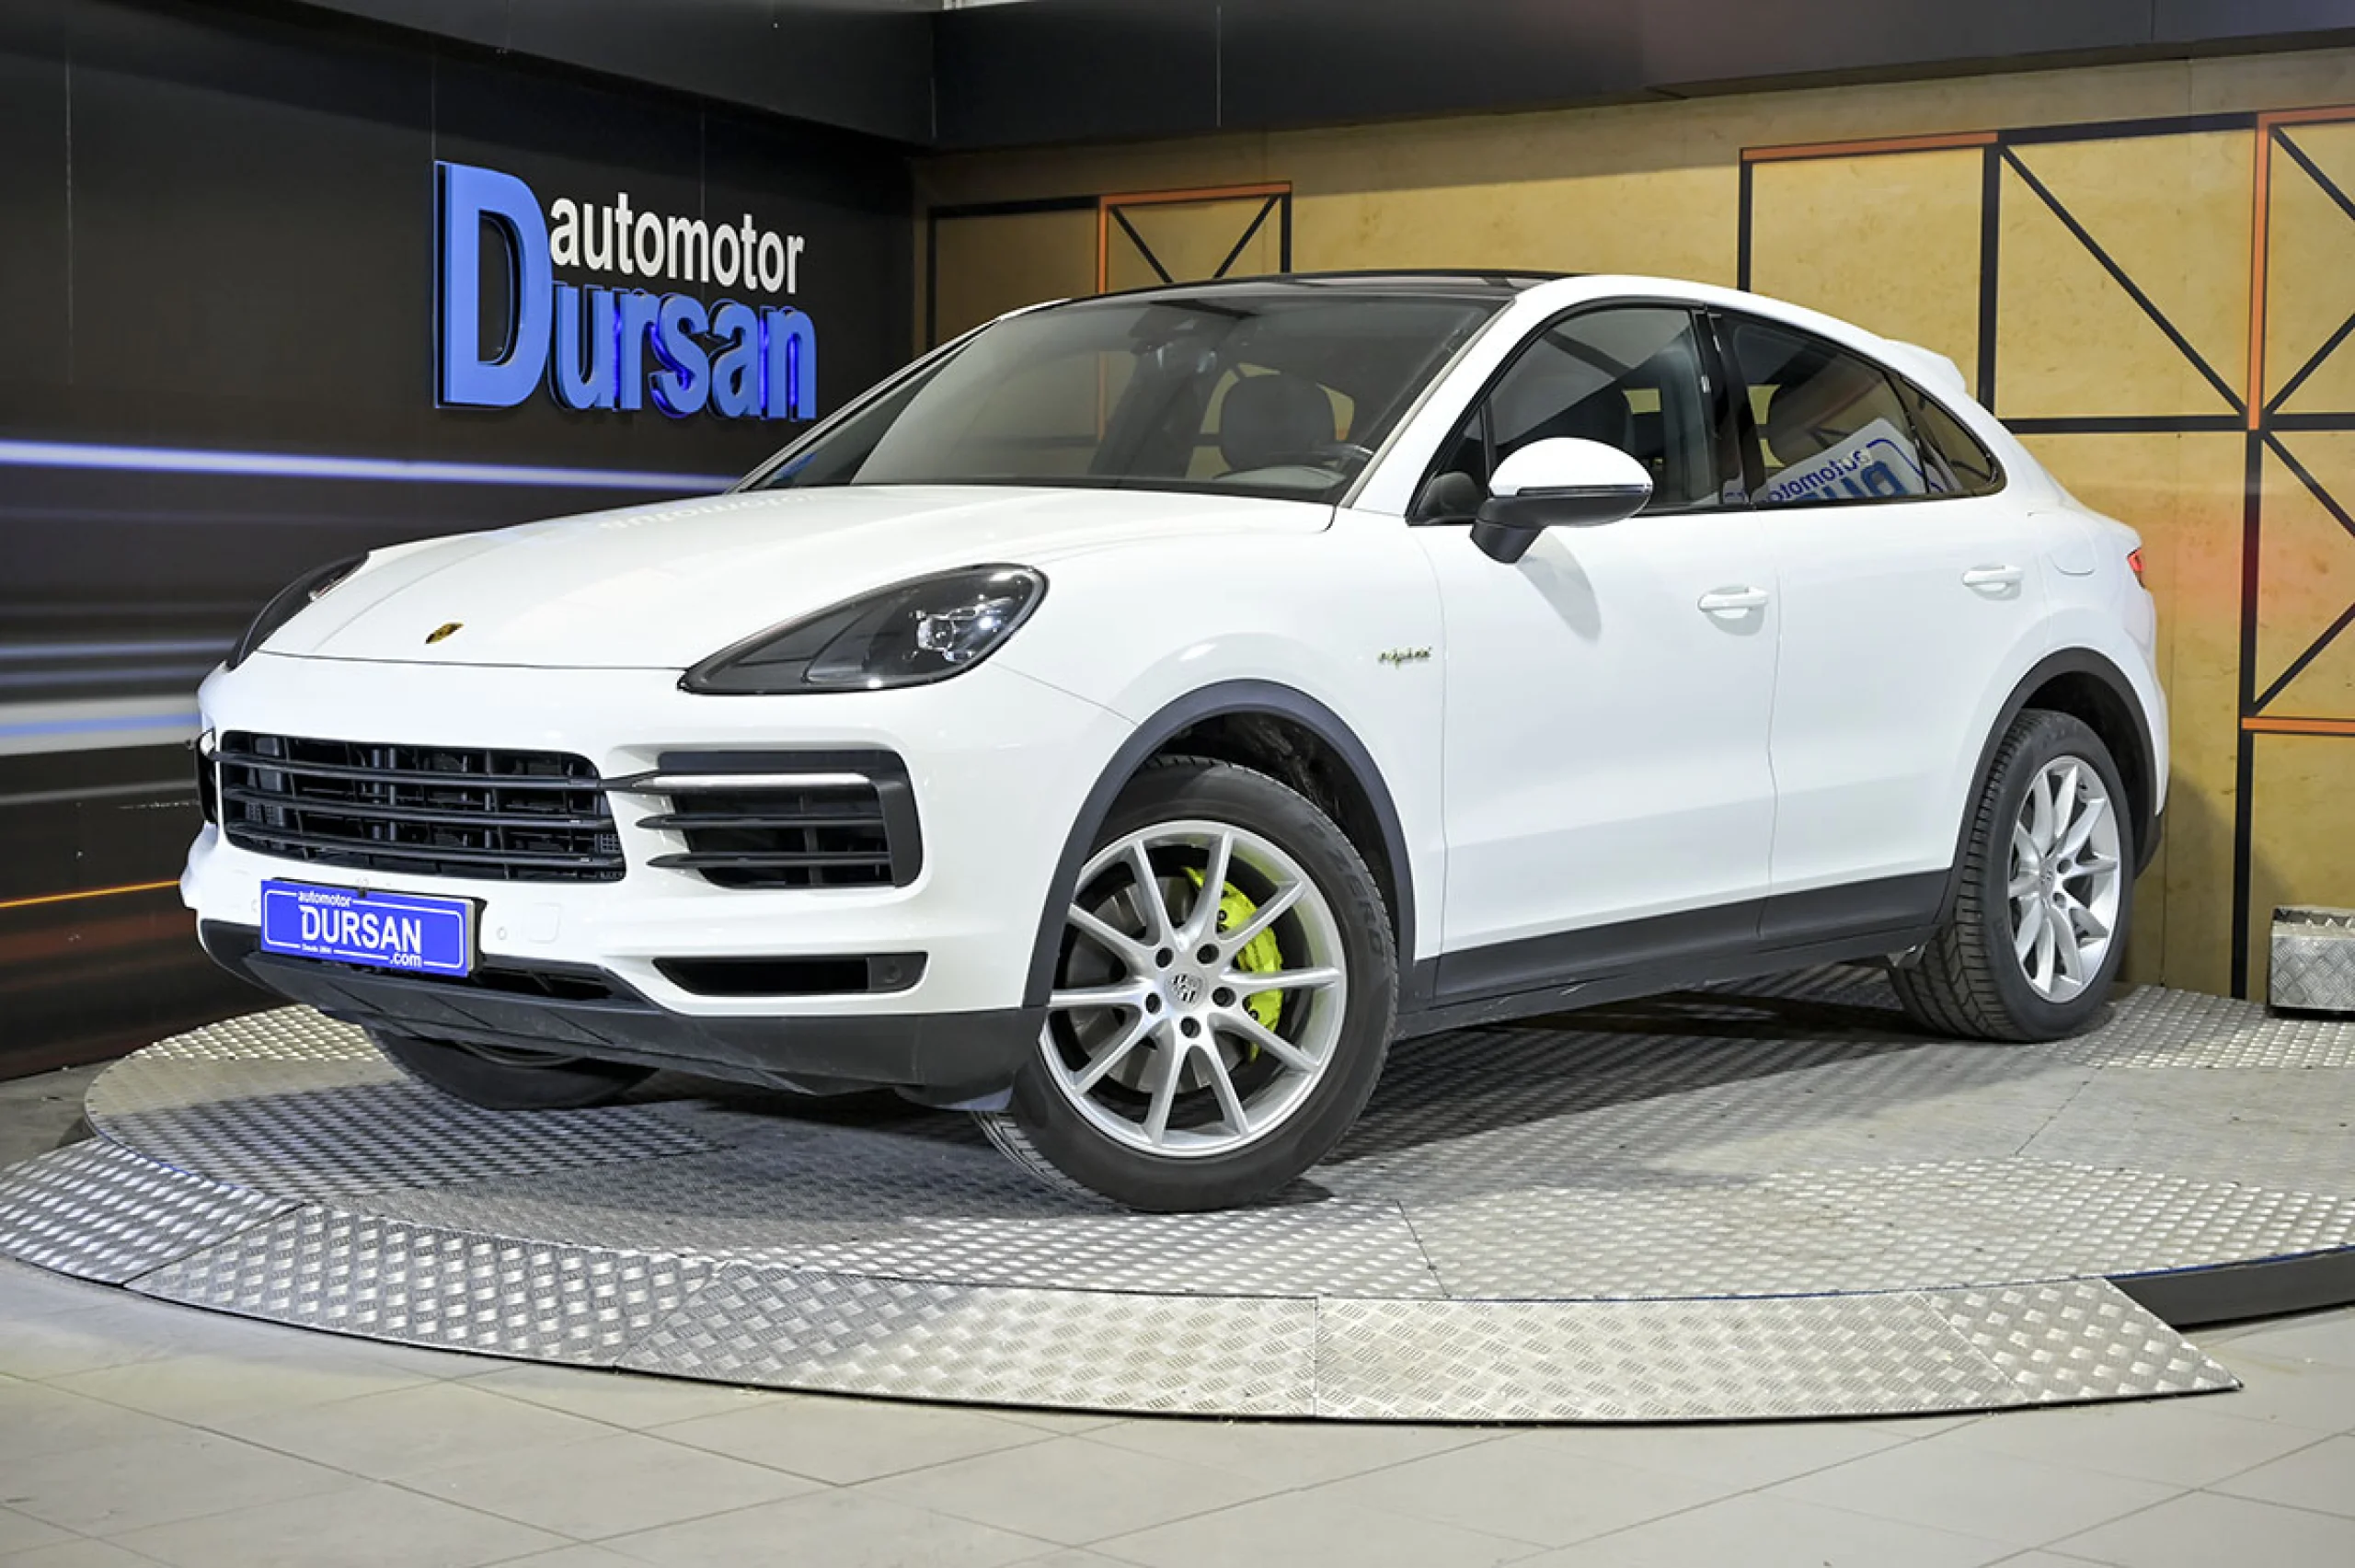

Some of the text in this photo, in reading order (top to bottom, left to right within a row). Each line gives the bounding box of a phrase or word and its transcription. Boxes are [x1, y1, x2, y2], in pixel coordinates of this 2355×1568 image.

[551, 191, 805, 294] automotor
[434, 160, 818, 422] Dursan
[297, 890, 351, 907] automotor
[298, 904, 422, 954] DURSAN
[389, 951, 423, 967] .com
